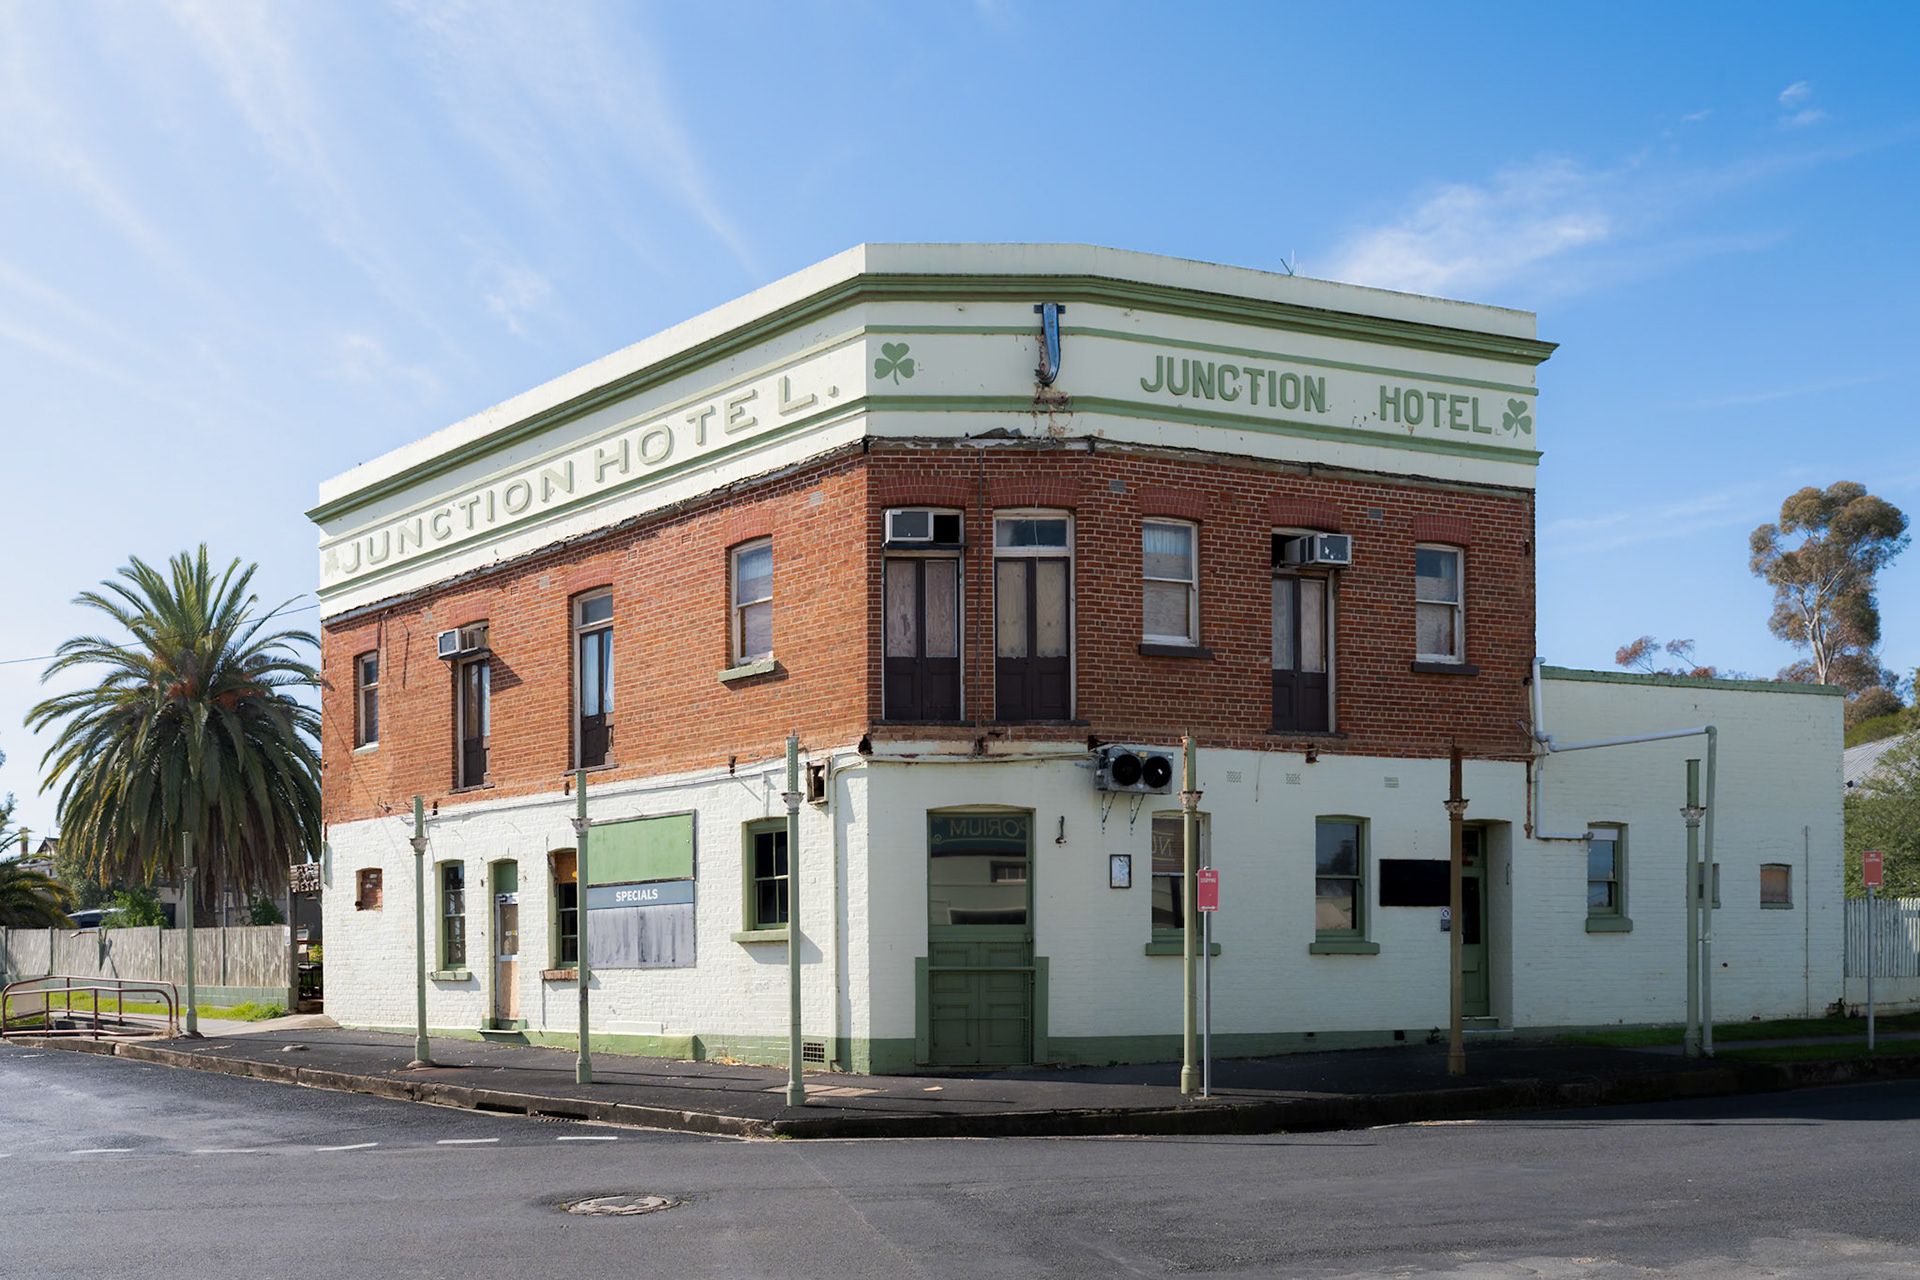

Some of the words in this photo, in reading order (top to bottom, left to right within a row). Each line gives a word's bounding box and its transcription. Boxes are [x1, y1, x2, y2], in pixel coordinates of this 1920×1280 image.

[1140, 355, 1326, 413] JUNCTION
[1379, 385, 1493, 435] HOTEL
[341, 459, 575, 575] JUNCTION
[594, 375, 840, 483] HOTEL.
[615, 889, 658, 902] SPECIALS
